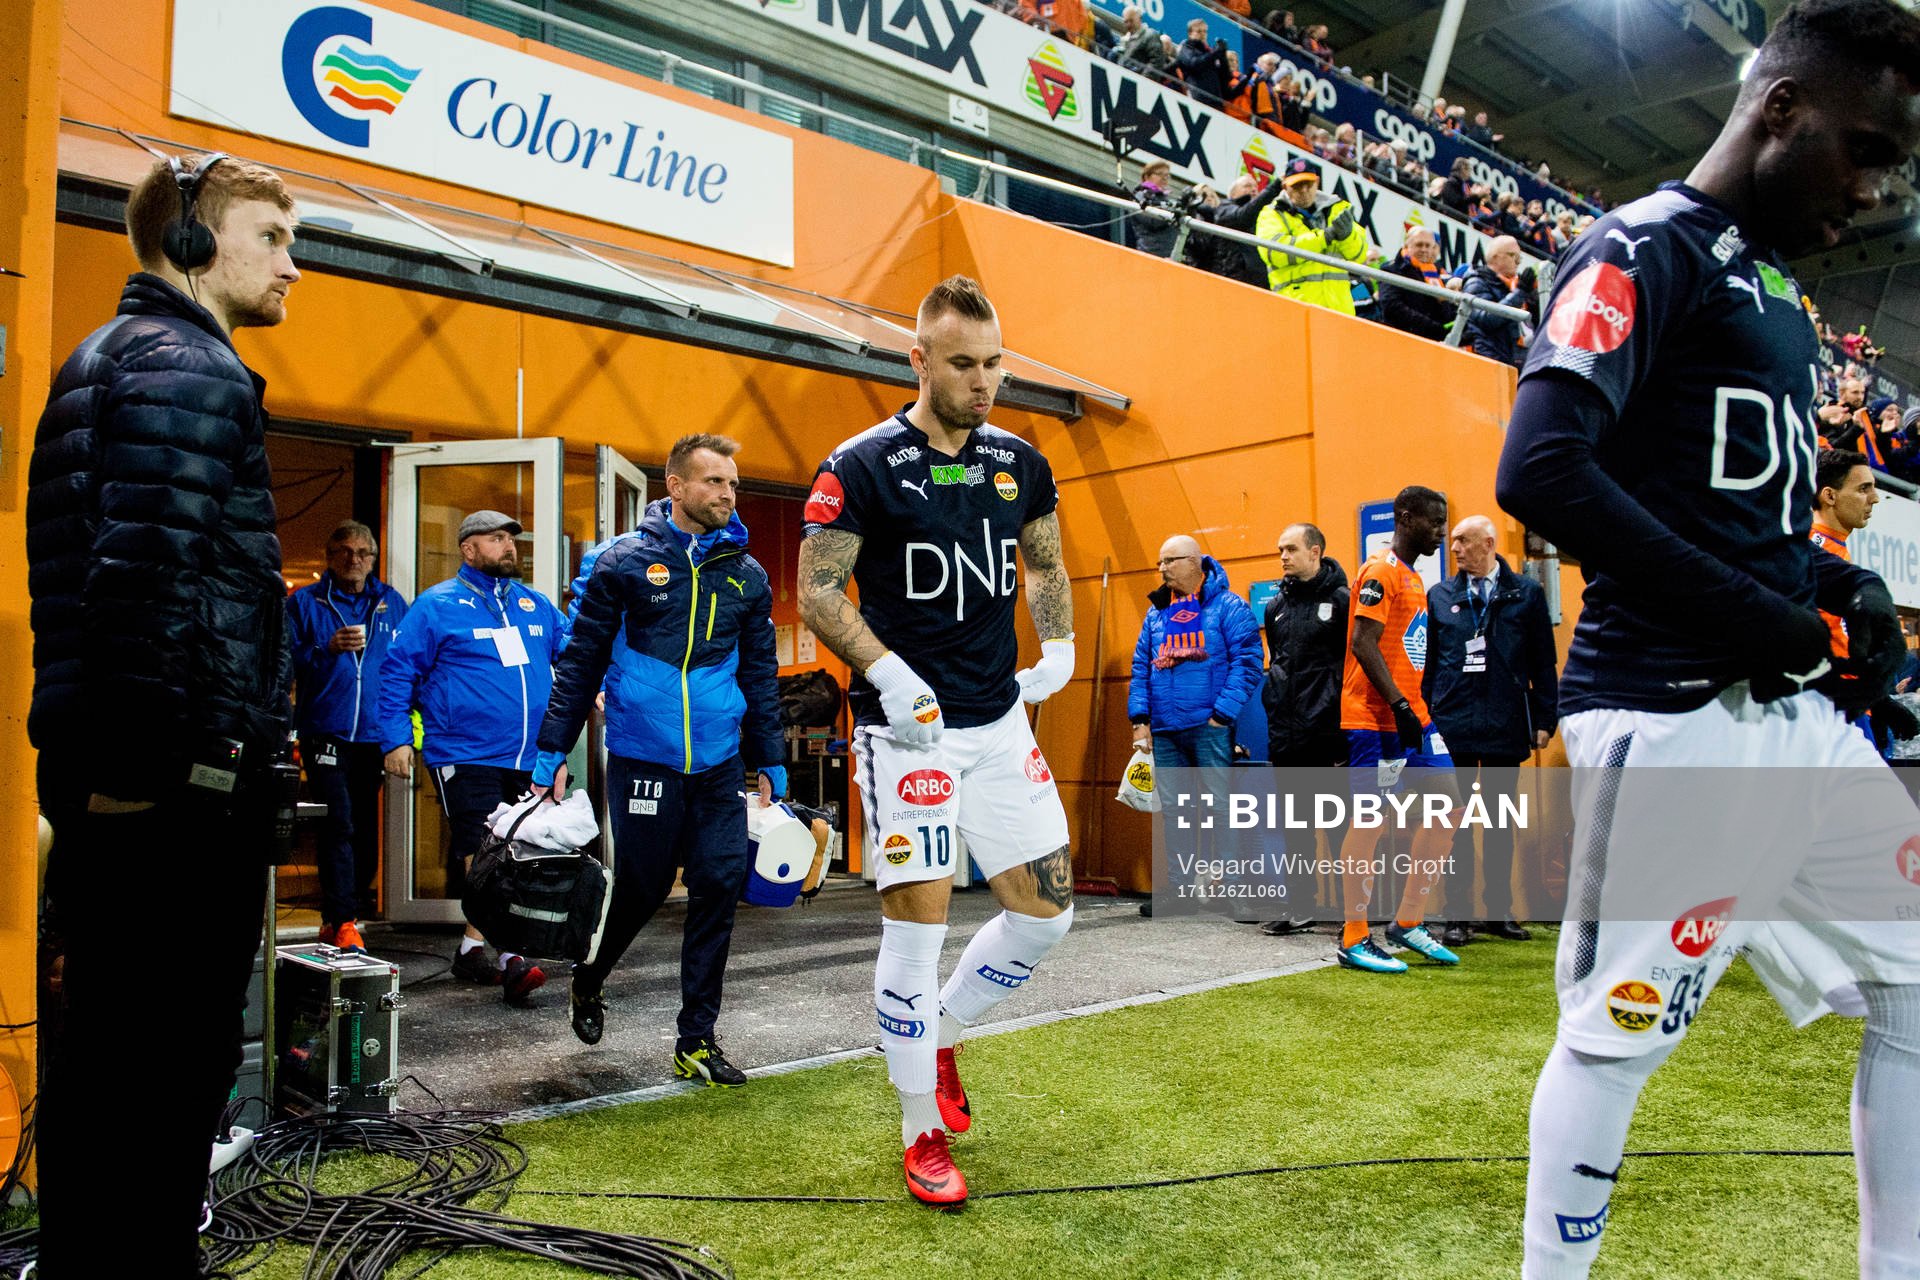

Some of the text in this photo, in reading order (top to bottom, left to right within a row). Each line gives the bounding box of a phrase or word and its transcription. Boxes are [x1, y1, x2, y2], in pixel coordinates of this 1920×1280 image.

[1091, 62, 1215, 180] MAX
[1374, 108, 1436, 161] coop
[447, 77, 728, 204] Color Line
[1468, 156, 1520, 200] coop
[1710, 363, 1817, 534] DN
[528, 624, 543, 637] RIV
[633, 779, 663, 799] TTØ
[901, 778, 954, 797] ARBO
[632, 799, 655, 814] DNB
[917, 825, 950, 868] 10
[878, 1013, 911, 1034] NTER
[1564, 1215, 1606, 1238] ENT
